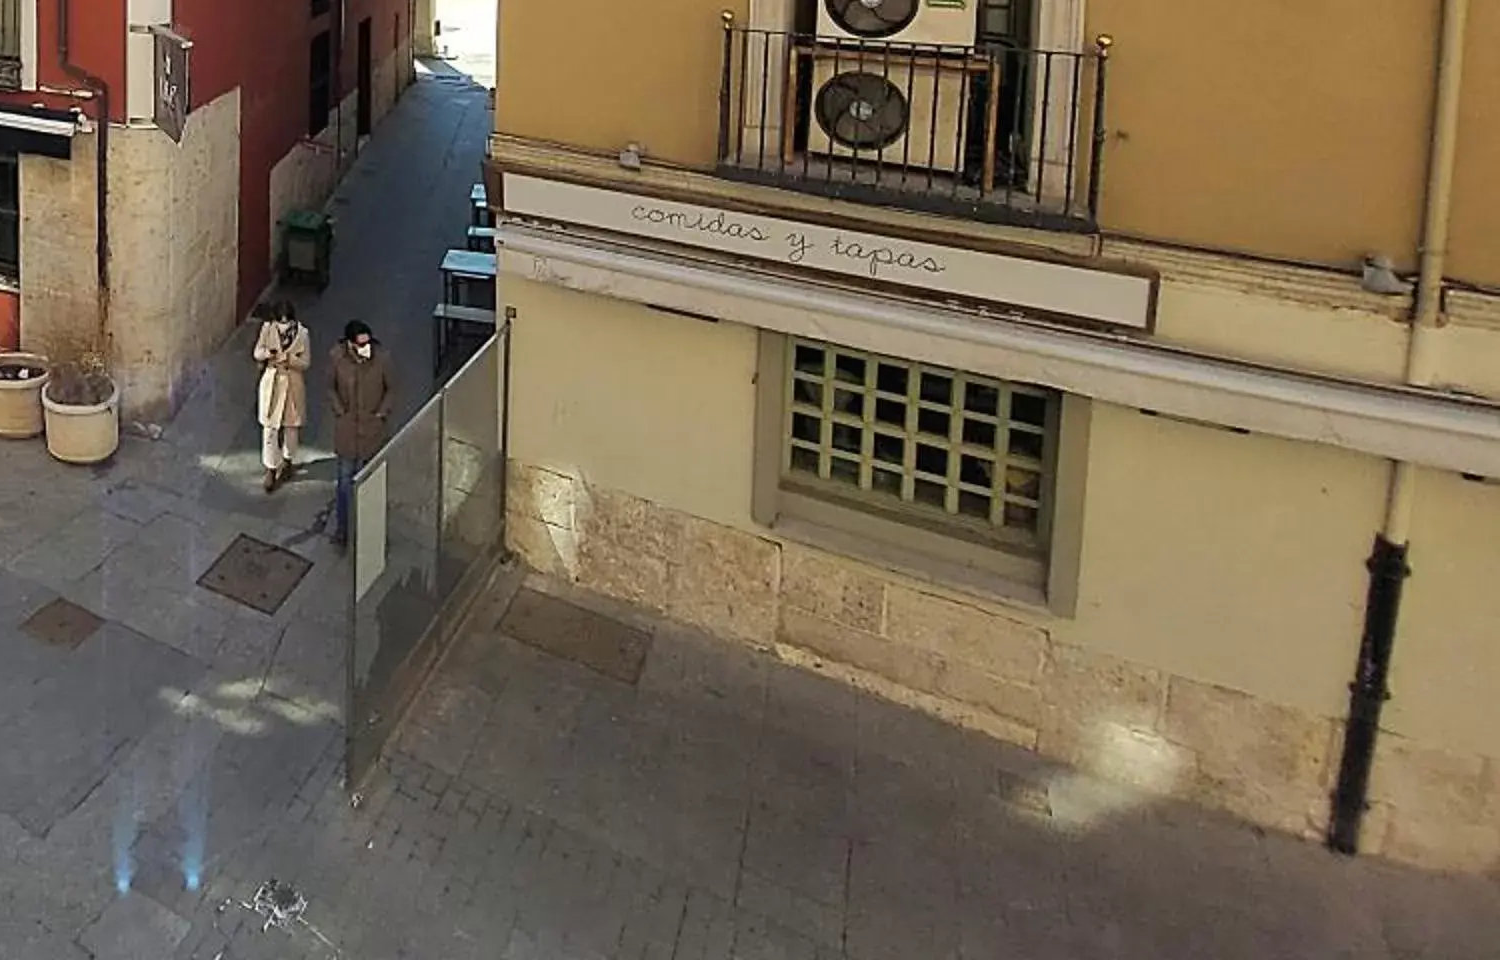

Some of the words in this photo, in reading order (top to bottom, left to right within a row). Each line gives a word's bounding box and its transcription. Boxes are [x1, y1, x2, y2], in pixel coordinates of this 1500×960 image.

[632, 204, 771, 241] comidas
[786, 231, 815, 263] y
[831, 235, 947, 276] tapas
